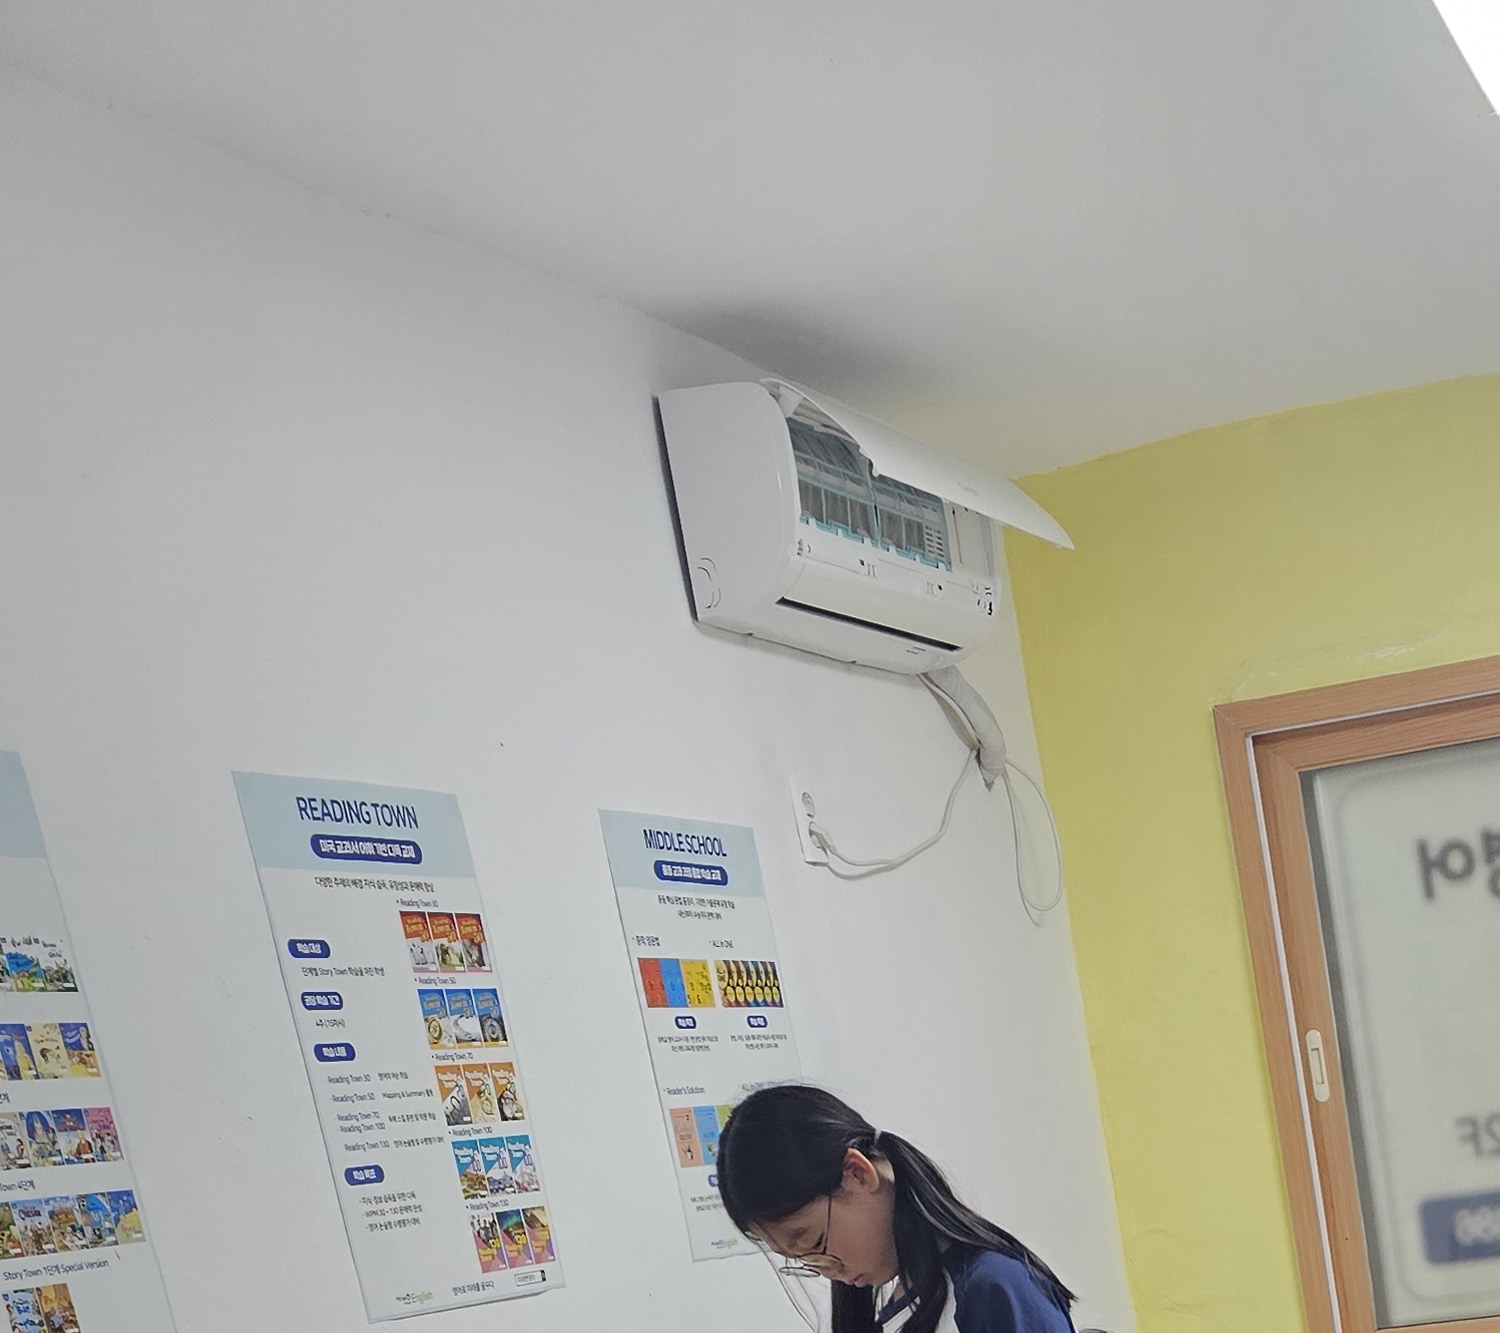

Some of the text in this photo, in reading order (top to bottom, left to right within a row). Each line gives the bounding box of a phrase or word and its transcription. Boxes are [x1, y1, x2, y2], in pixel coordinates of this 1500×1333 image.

[296, 796, 419, 829] READING TOWN
[643, 829, 727, 857] MIDDLE SCHOOL
[400, 899, 420, 908] Reading
[320, 967, 347, 977] Story Town
[418, 976, 449, 986] Reading Town
[435, 1053, 454, 1061] Reading
[328, 1075, 363, 1085] Reading Town
[333, 1093, 368, 1103] Reading Town
[336, 1113, 371, 1122] Reading Town
[340, 1125, 362, 1134] Reading
[362, 1124, 375, 1132] Town
[344, 1142, 379, 1152] Reading Town
[3, 1259, 109, 1281] Story Town 1단계 Special Version
